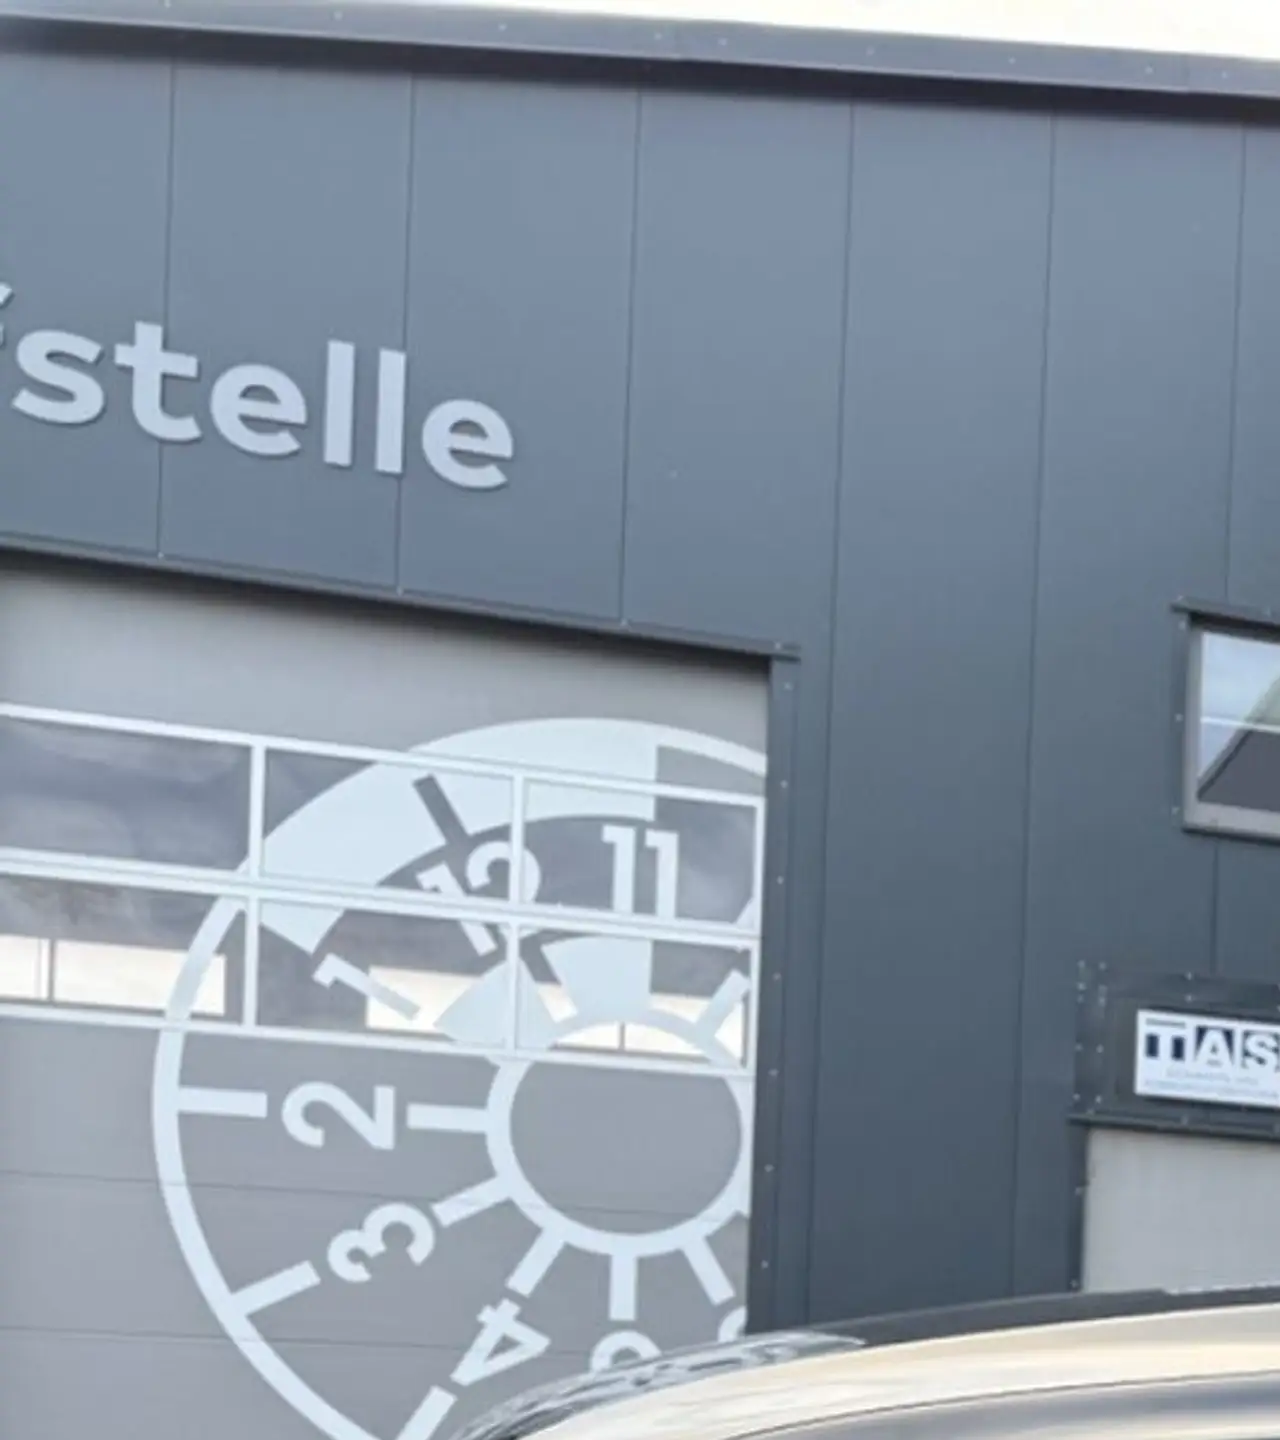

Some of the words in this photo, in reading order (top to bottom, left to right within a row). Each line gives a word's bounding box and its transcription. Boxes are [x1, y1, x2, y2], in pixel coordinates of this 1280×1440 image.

[603, 824, 678, 920] 11
[281, 1081, 395, 1151] 2
[327, 1203, 436, 1283] 3
[449, 1298, 551, 1387] 4
